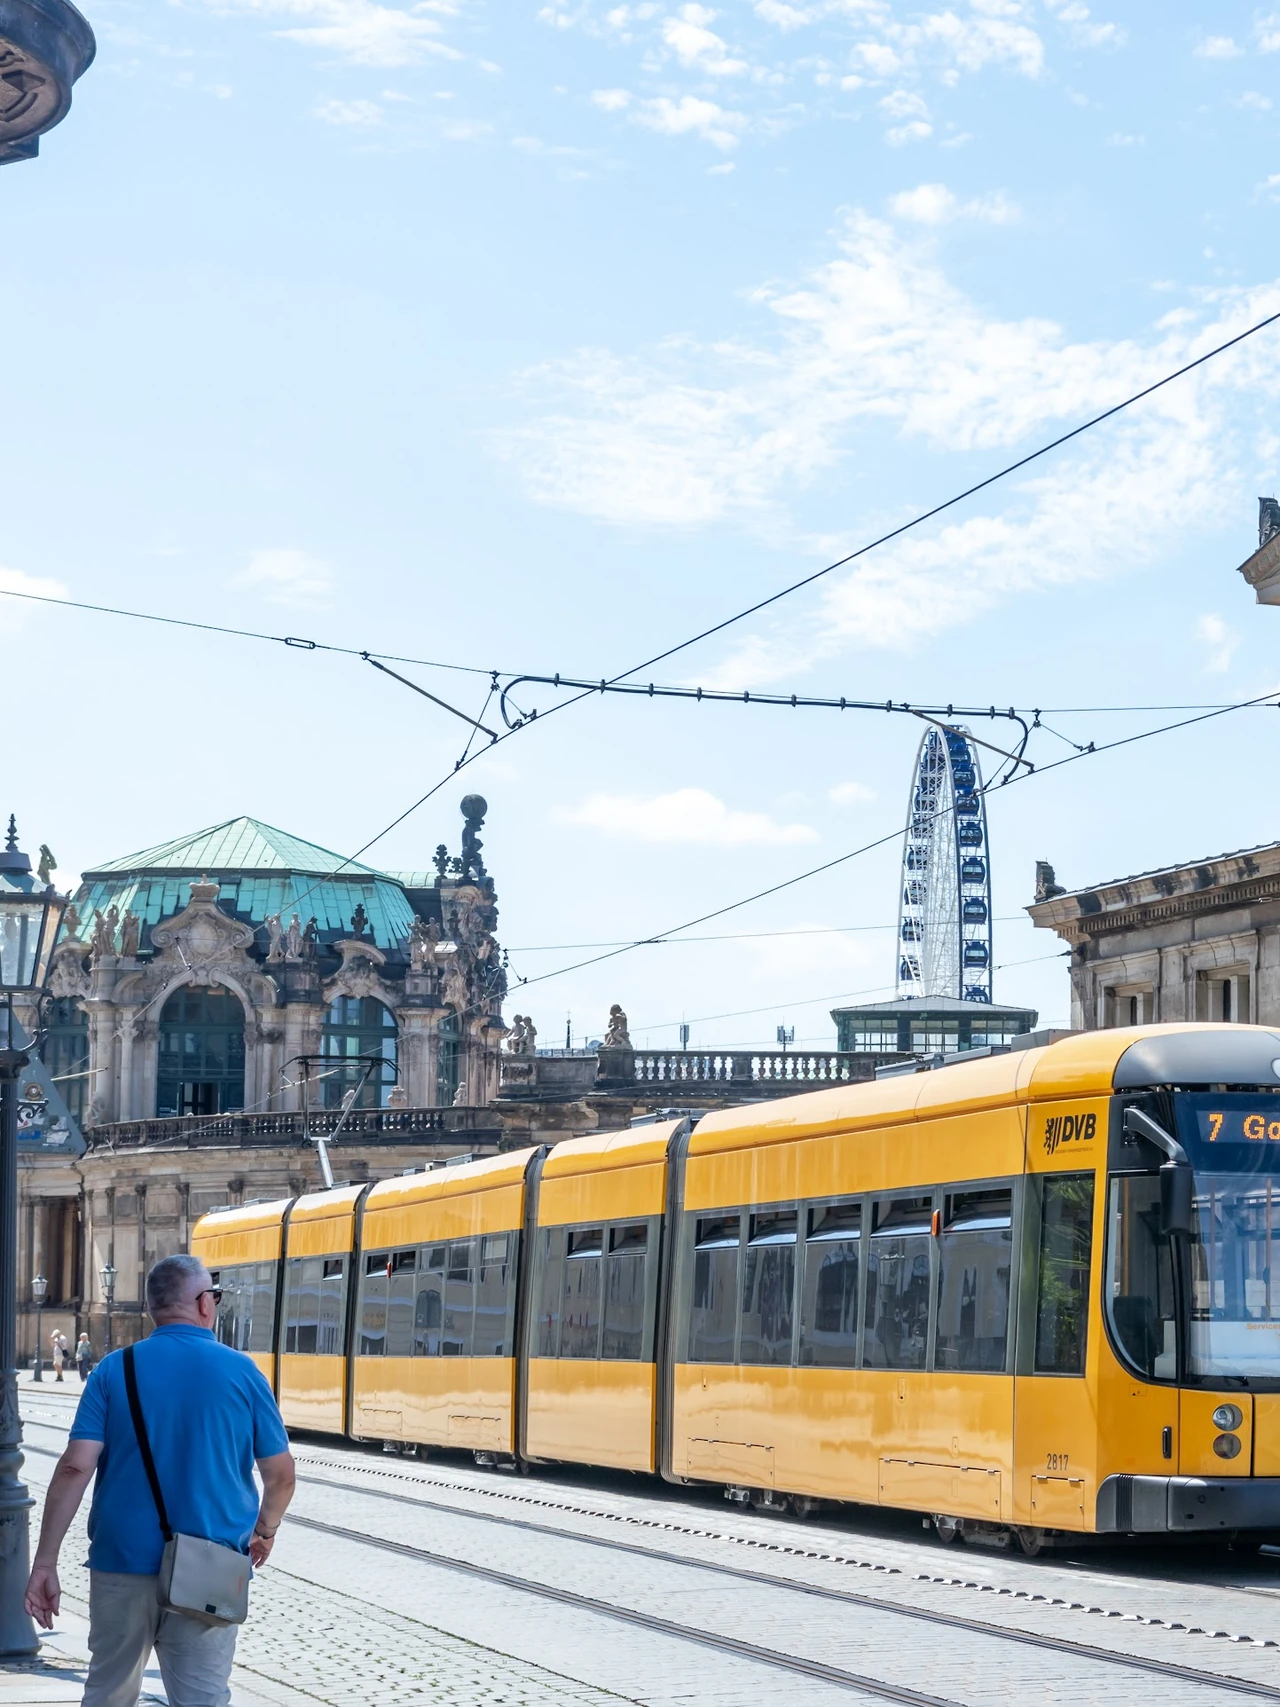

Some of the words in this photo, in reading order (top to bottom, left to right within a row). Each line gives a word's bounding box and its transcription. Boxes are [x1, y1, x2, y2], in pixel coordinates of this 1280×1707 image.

[1061, 1113, 1097, 1142] DVB
[1208, 1112, 1224, 1142] 7
[1046, 1452, 1069, 1471] 2817
